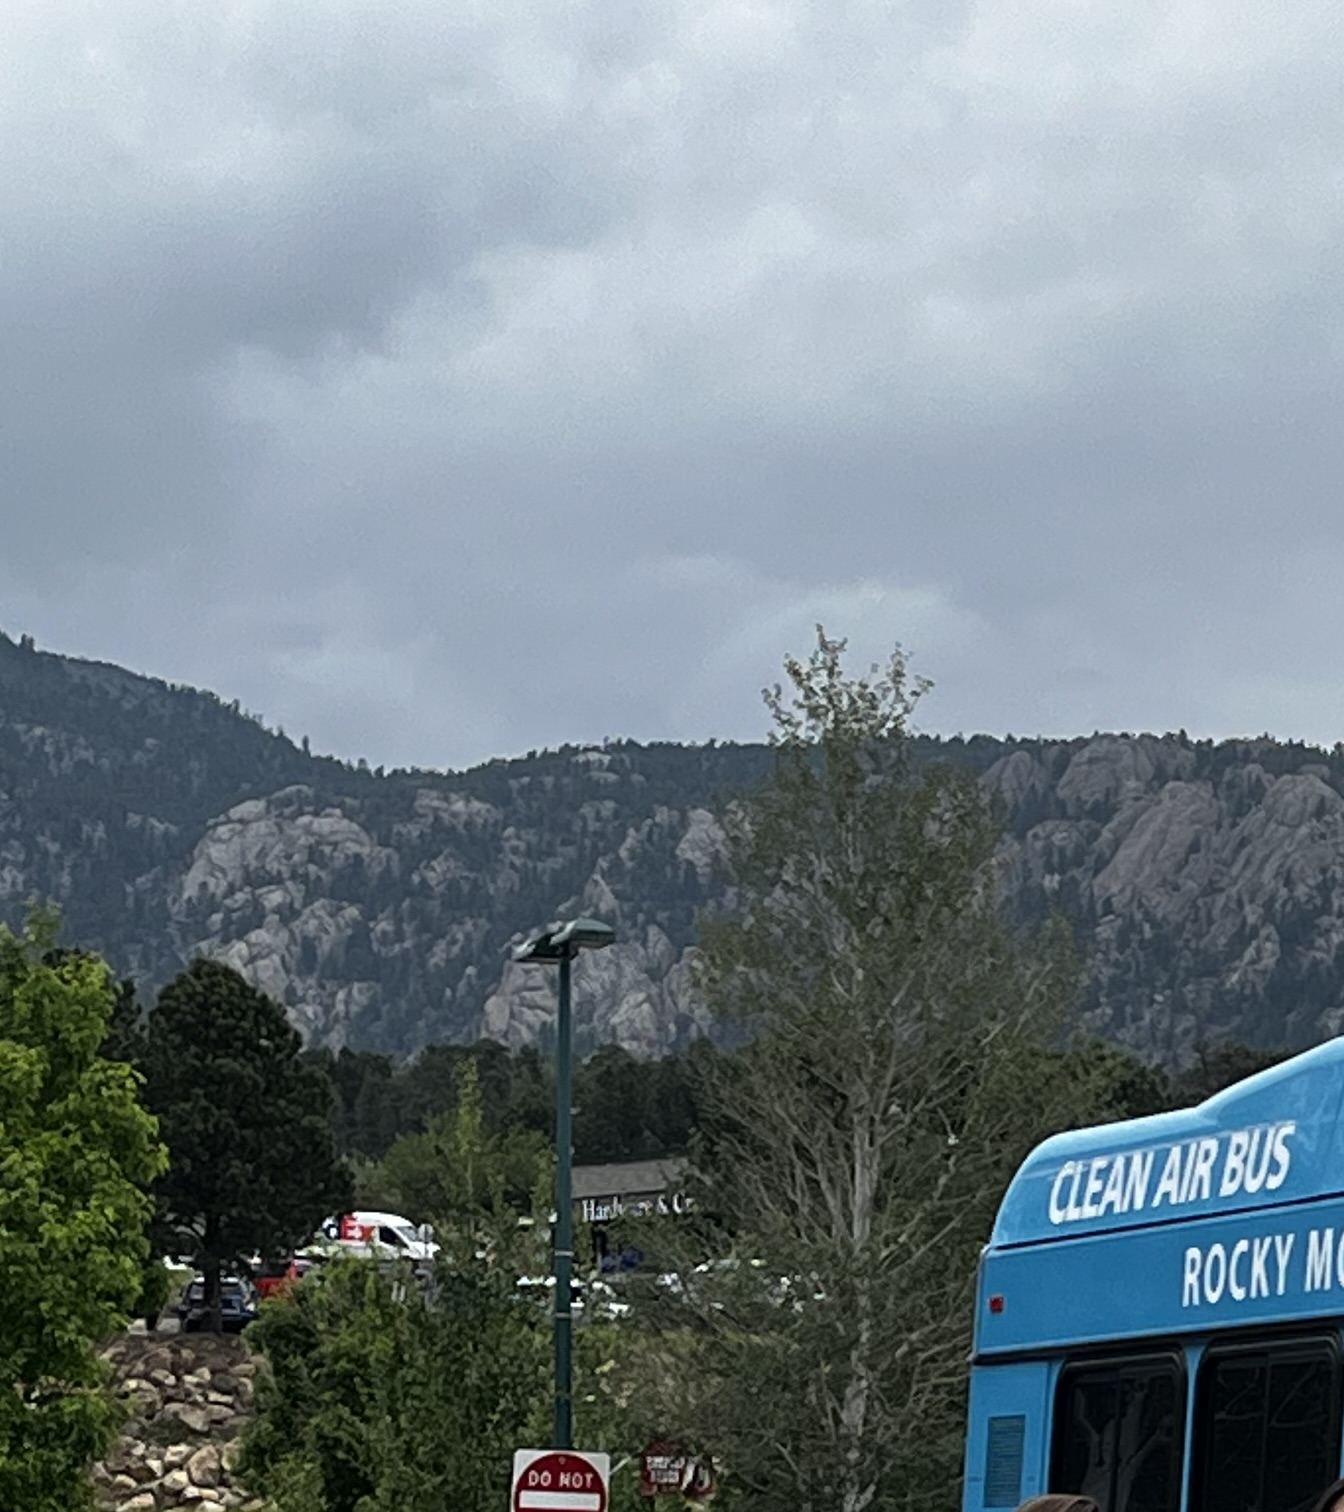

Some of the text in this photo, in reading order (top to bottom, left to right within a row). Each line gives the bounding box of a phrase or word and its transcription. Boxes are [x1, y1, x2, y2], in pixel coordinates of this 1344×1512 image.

[1049, 1122, 1296, 1225] CLEAN AIR BUS
[581, 1195, 652, 1223] Hard
[1183, 1232, 1295, 1306] ROCKY
[528, 1469, 595, 1489] DO NOT
